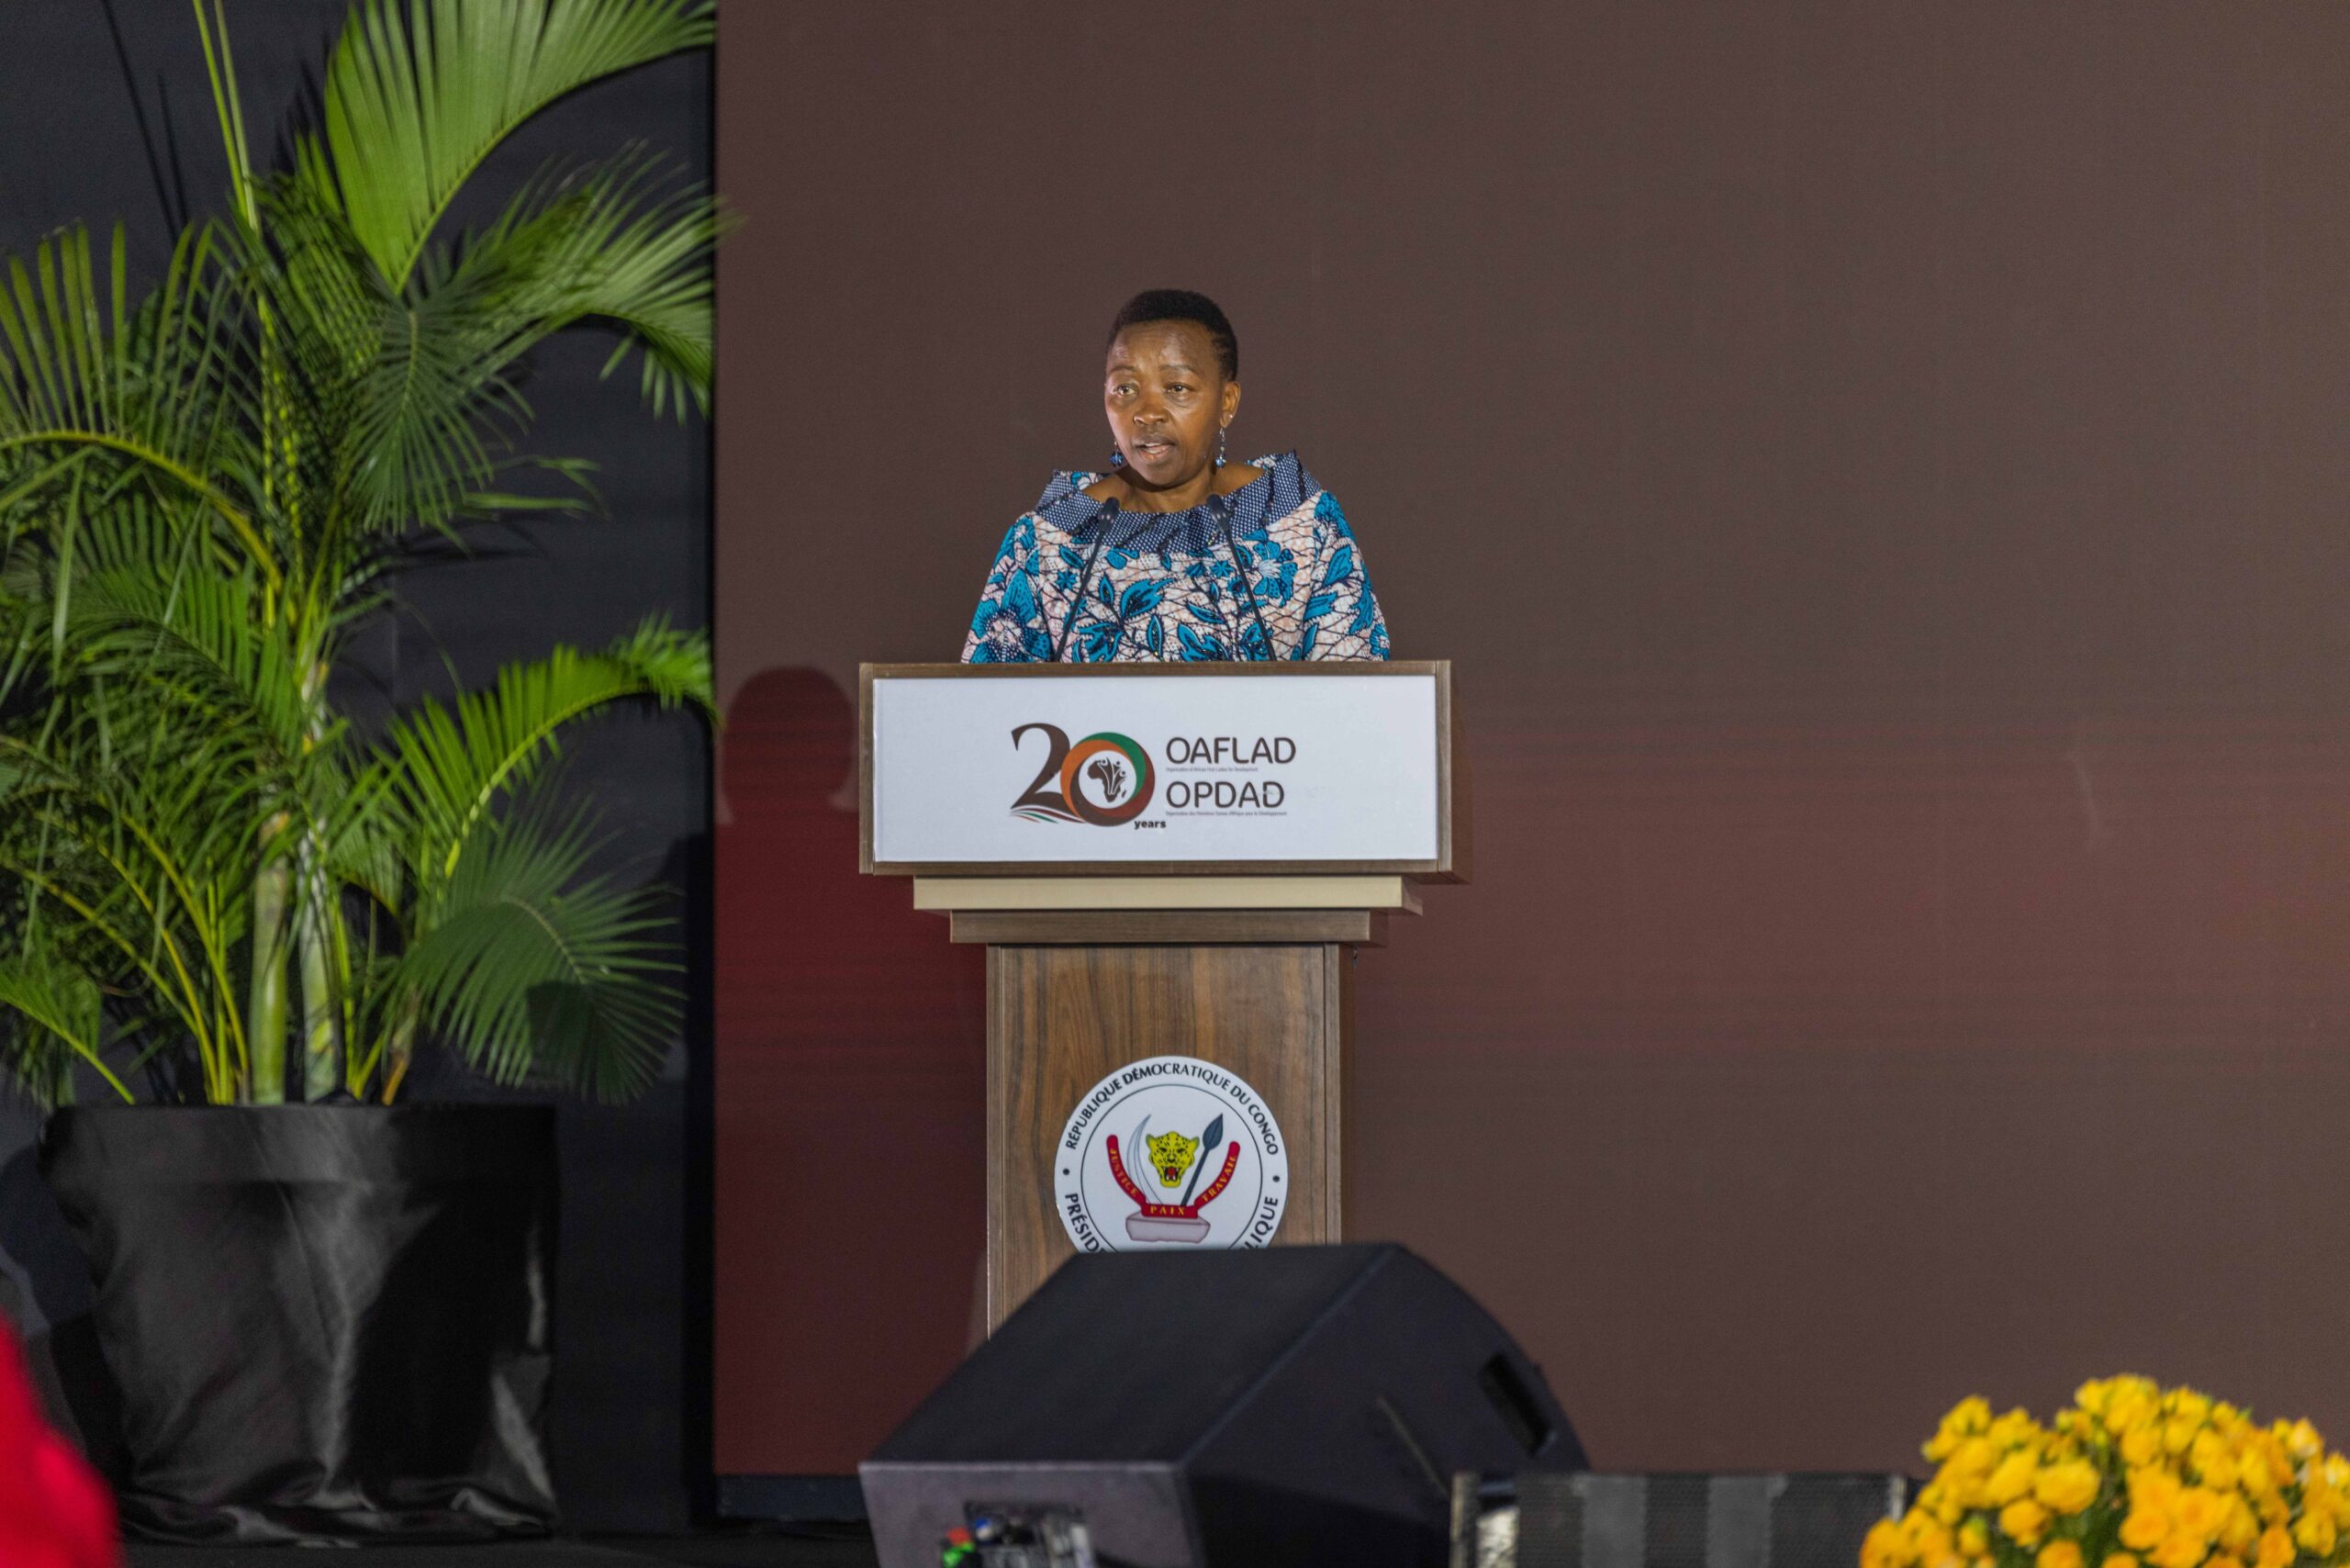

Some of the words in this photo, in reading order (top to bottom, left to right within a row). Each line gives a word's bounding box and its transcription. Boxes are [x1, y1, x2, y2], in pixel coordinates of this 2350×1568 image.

[1011, 722, 1156, 826] 20
[1166, 737, 1296, 764] OAFLAD
[1166, 781, 1284, 809] OPDAD
[1134, 819, 1166, 830] years
[1065, 1081, 1122, 1149] RÉPUBLIQUE
[1123, 1063, 1231, 1091] DÉMOCRATIQUE
[1229, 1085, 1251, 1105] DU
[1248, 1104, 1279, 1156] CONGO
[1109, 1148, 1138, 1197] JUSTICE
[1201, 1155, 1237, 1202] TRAVAIL
[1065, 1193, 1107, 1252] PRÉSID
[1149, 1206, 1186, 1215] PAIX
